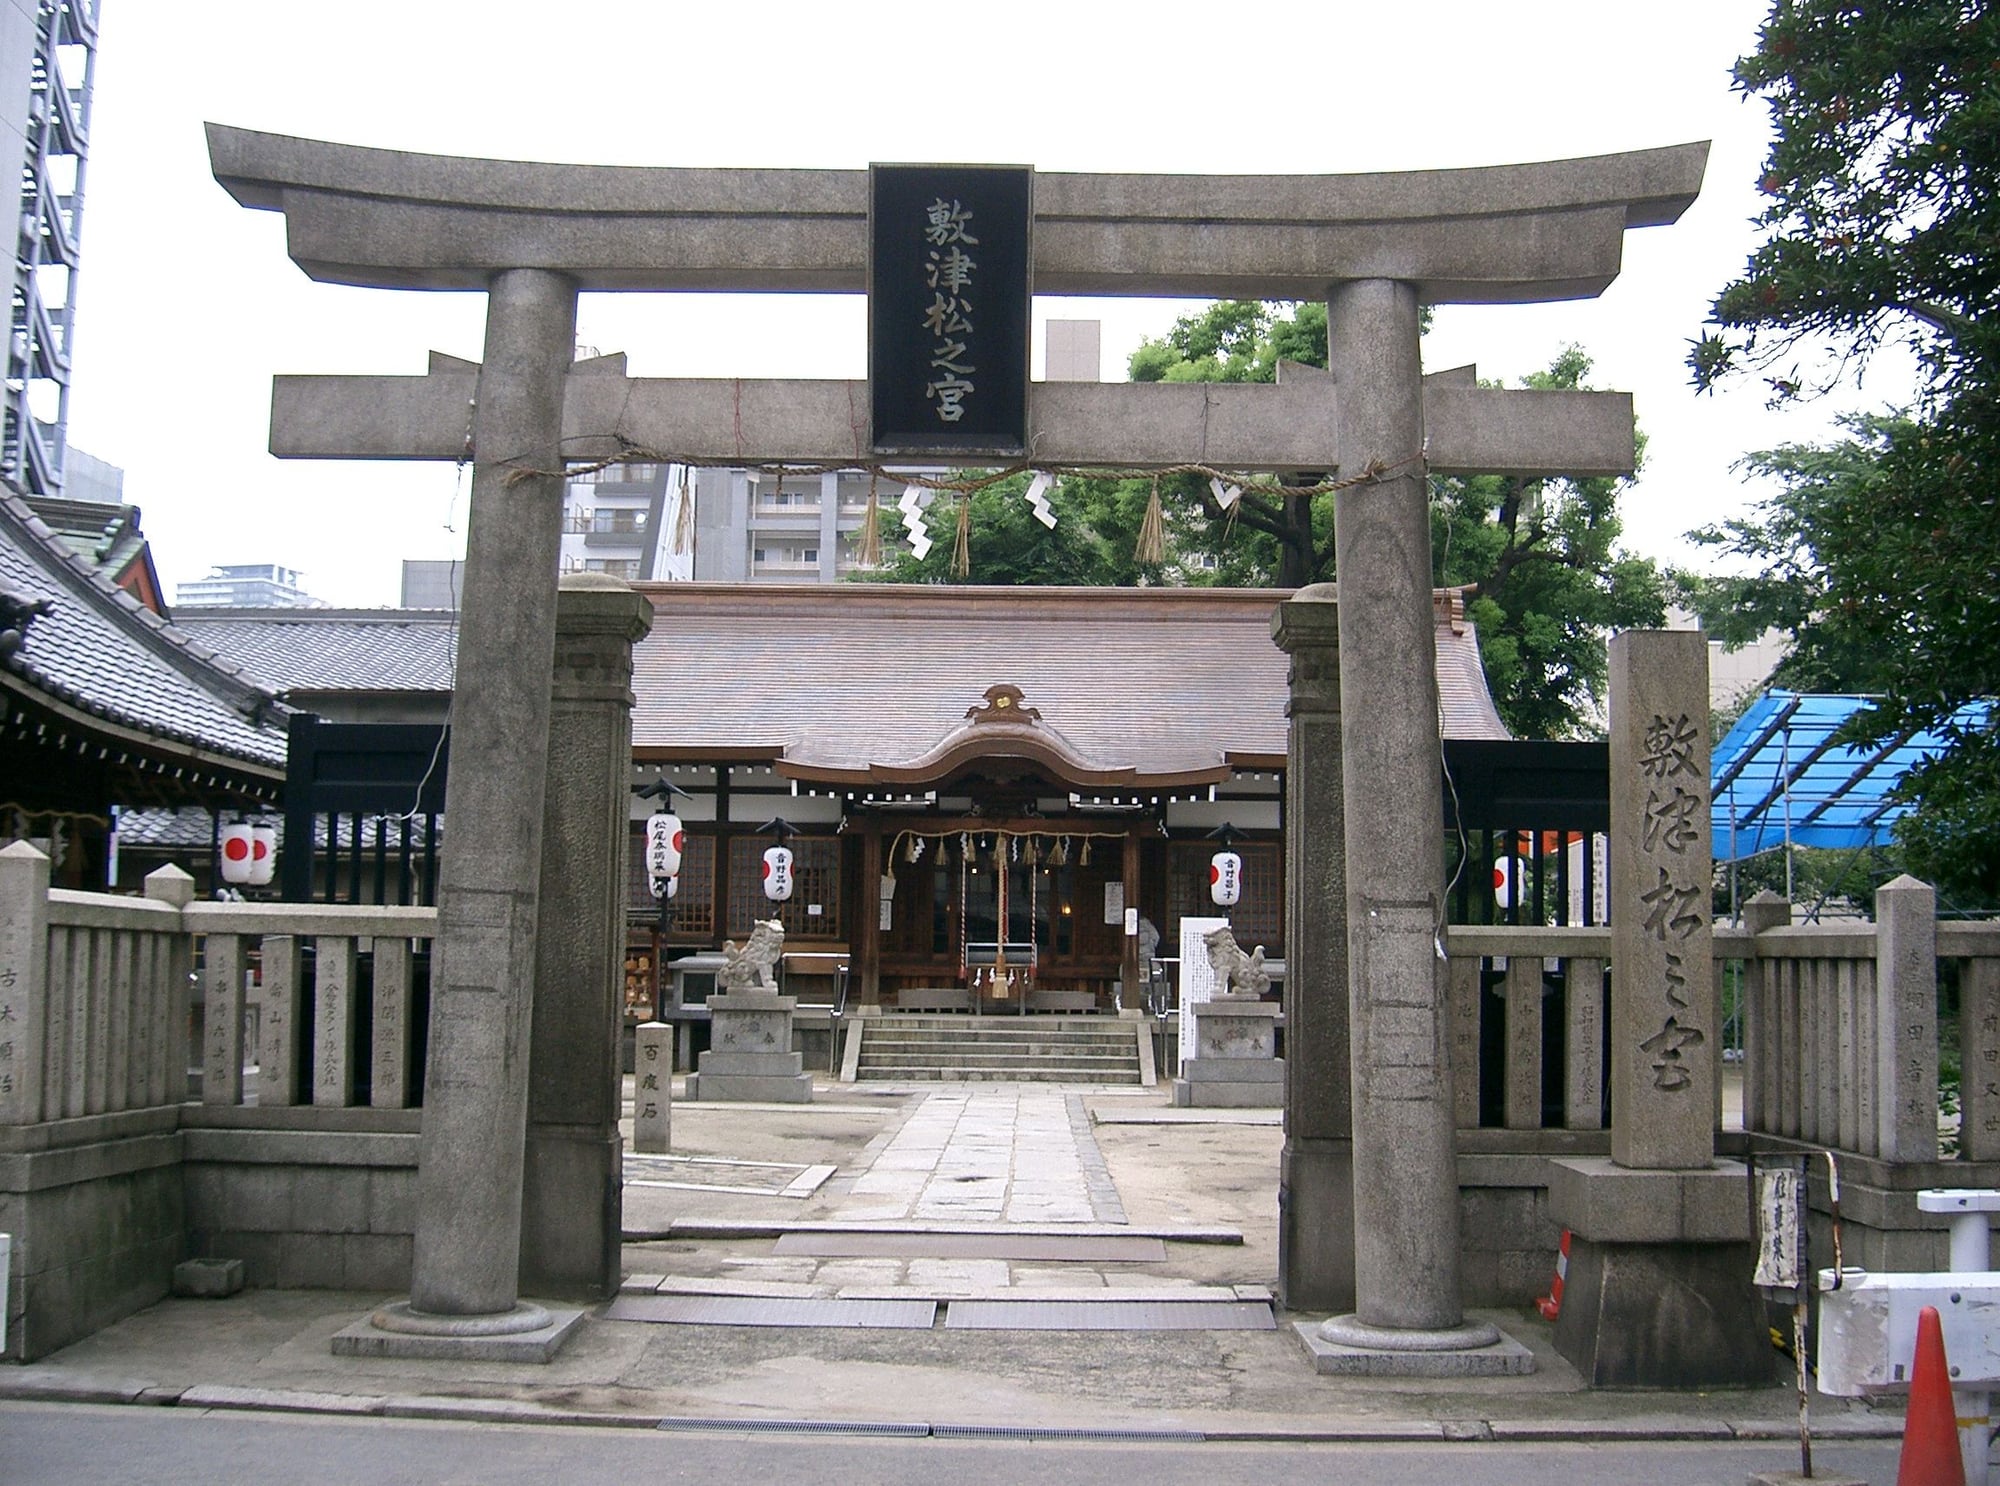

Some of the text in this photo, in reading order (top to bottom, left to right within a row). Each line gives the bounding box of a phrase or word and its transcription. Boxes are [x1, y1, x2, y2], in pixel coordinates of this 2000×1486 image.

[922, 197, 979, 422] 敷津松之宮
[642, 1044, 659, 1119] 百度石
